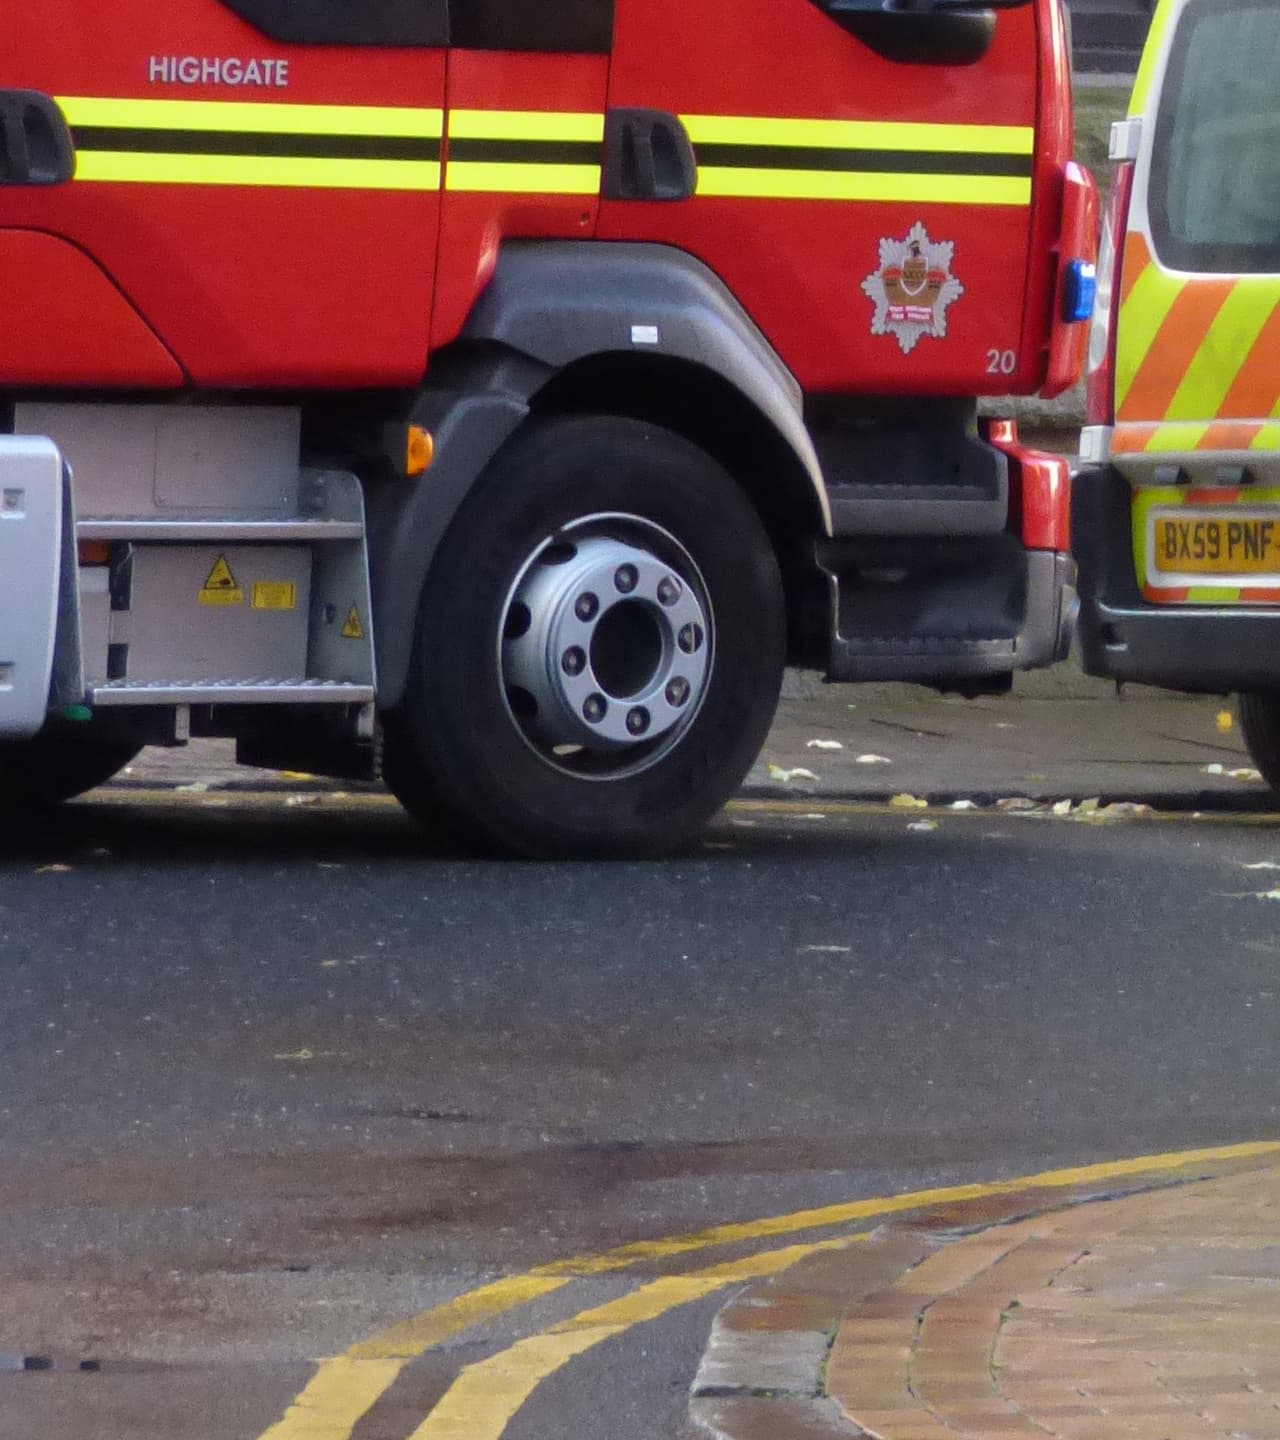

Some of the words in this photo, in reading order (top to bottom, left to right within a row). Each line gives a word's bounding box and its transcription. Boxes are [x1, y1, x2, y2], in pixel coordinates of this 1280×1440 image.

[148, 56, 289, 87] HIGHGATE
[986, 348, 1016, 374] 20
[1164, 520, 1220, 560] BX59
[1227, 520, 1274, 561] PNF
